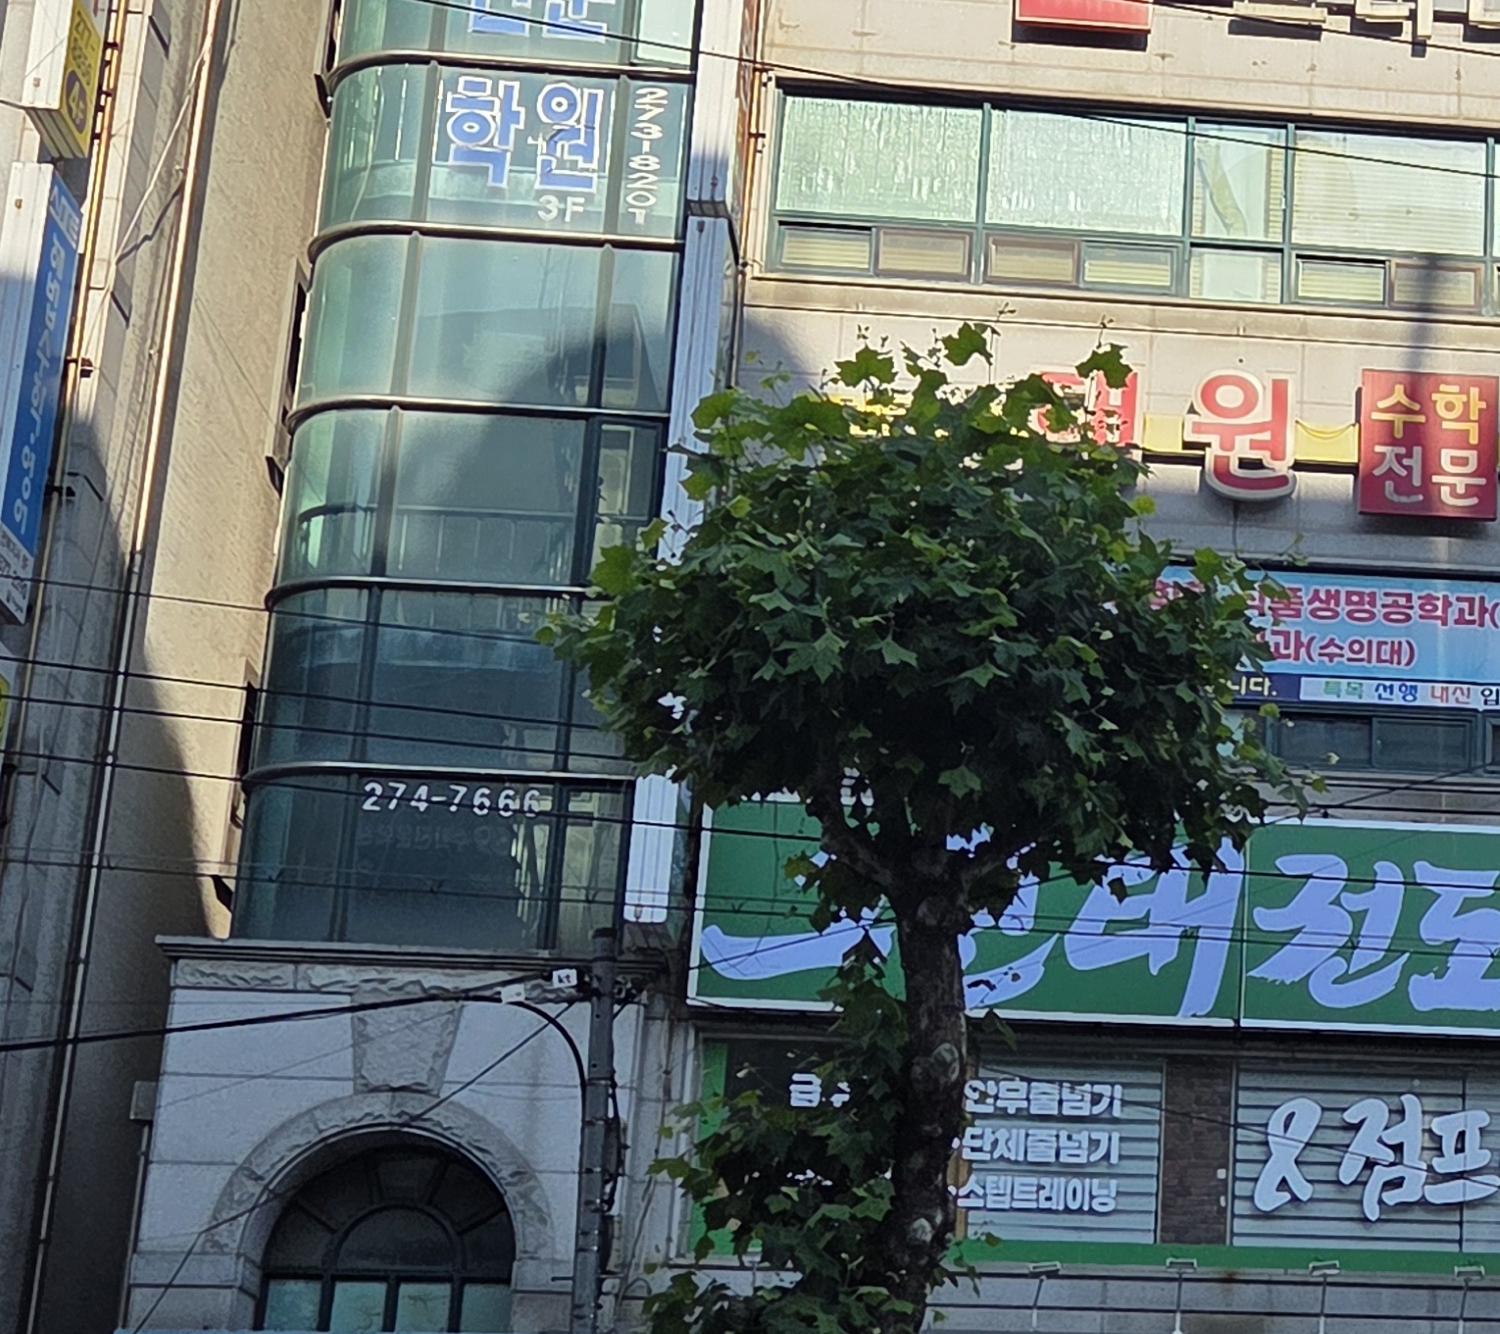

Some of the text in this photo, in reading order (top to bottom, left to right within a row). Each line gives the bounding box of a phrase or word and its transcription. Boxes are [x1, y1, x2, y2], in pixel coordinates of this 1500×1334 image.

[445, 73, 604, 192] 학원
[536, 195, 586, 223] 3F
[1370, 384, 1487, 445] 수학
[1371, 446, 1488, 507] 전문
[1375, 683, 1419, 704] 선행
[362, 781, 541, 817] 274-7666
[962, 1127, 1120, 1165] 단체줄넘기
